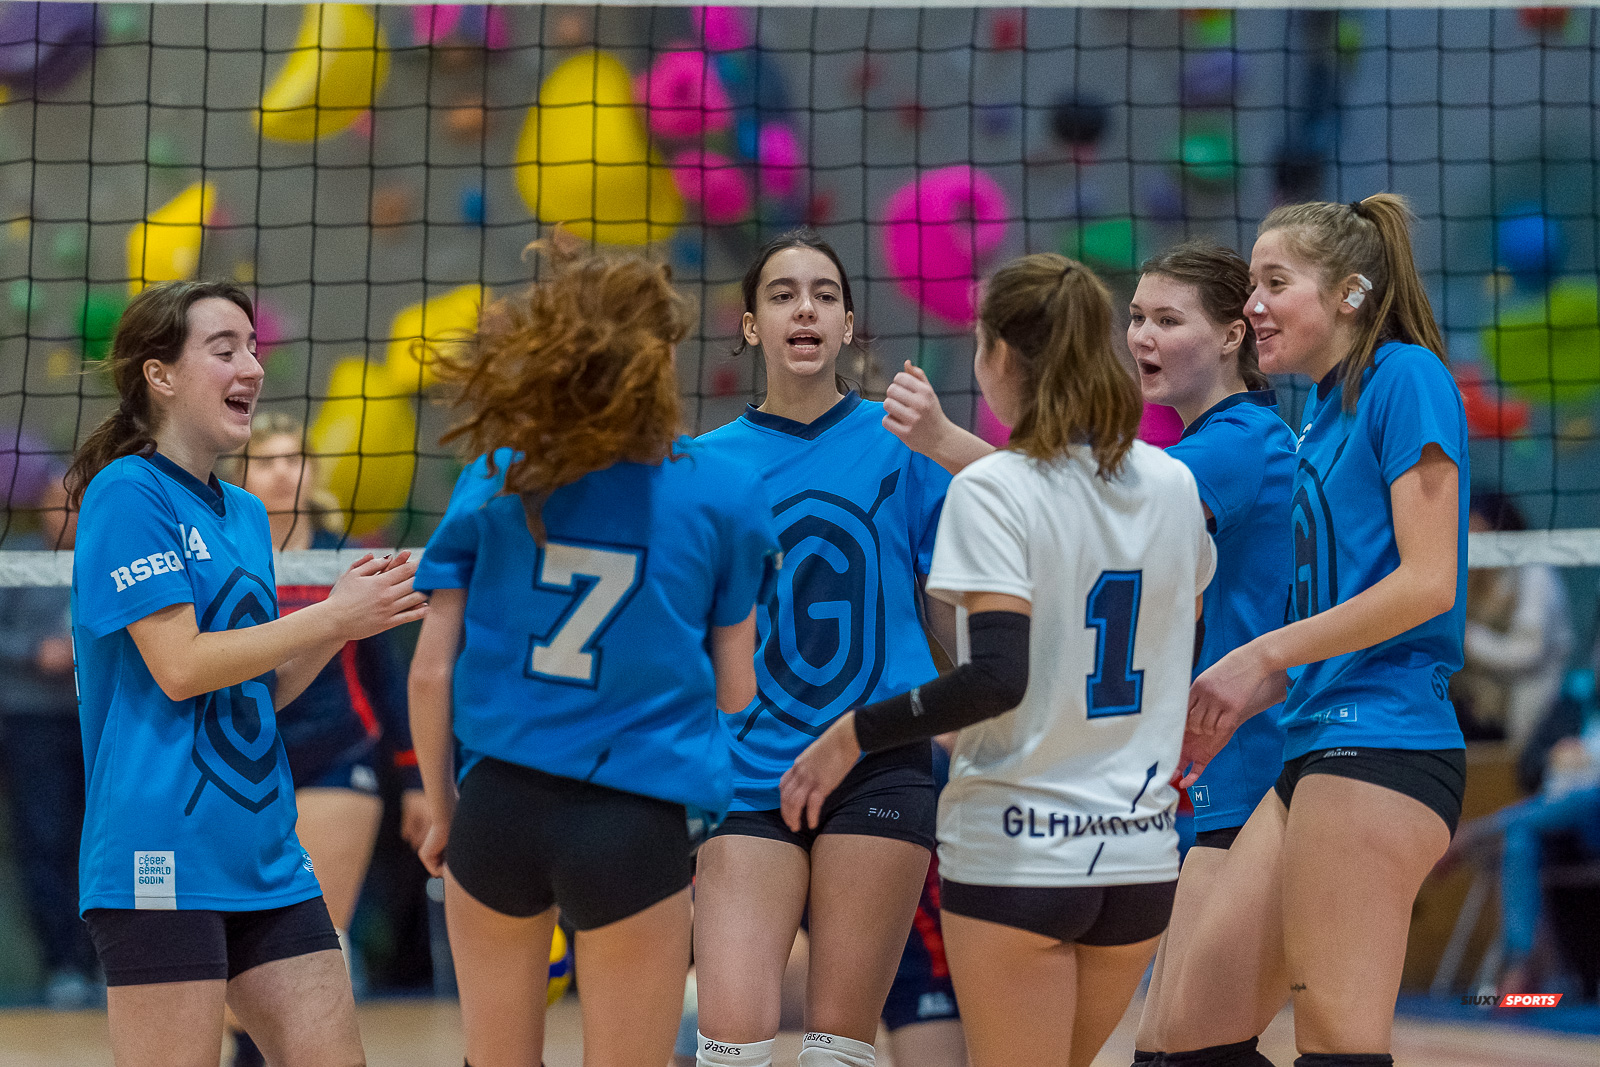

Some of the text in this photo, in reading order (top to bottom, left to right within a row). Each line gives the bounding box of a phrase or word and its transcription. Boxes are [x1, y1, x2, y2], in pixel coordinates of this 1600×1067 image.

[110, 550, 184, 593] RSEQ
[526, 538, 645, 688] 7
[776, 535, 852, 687] G
[1085, 569, 1145, 720] 1
[1195, 791, 1203, 801] M
[138, 876, 164, 885] GODIN
